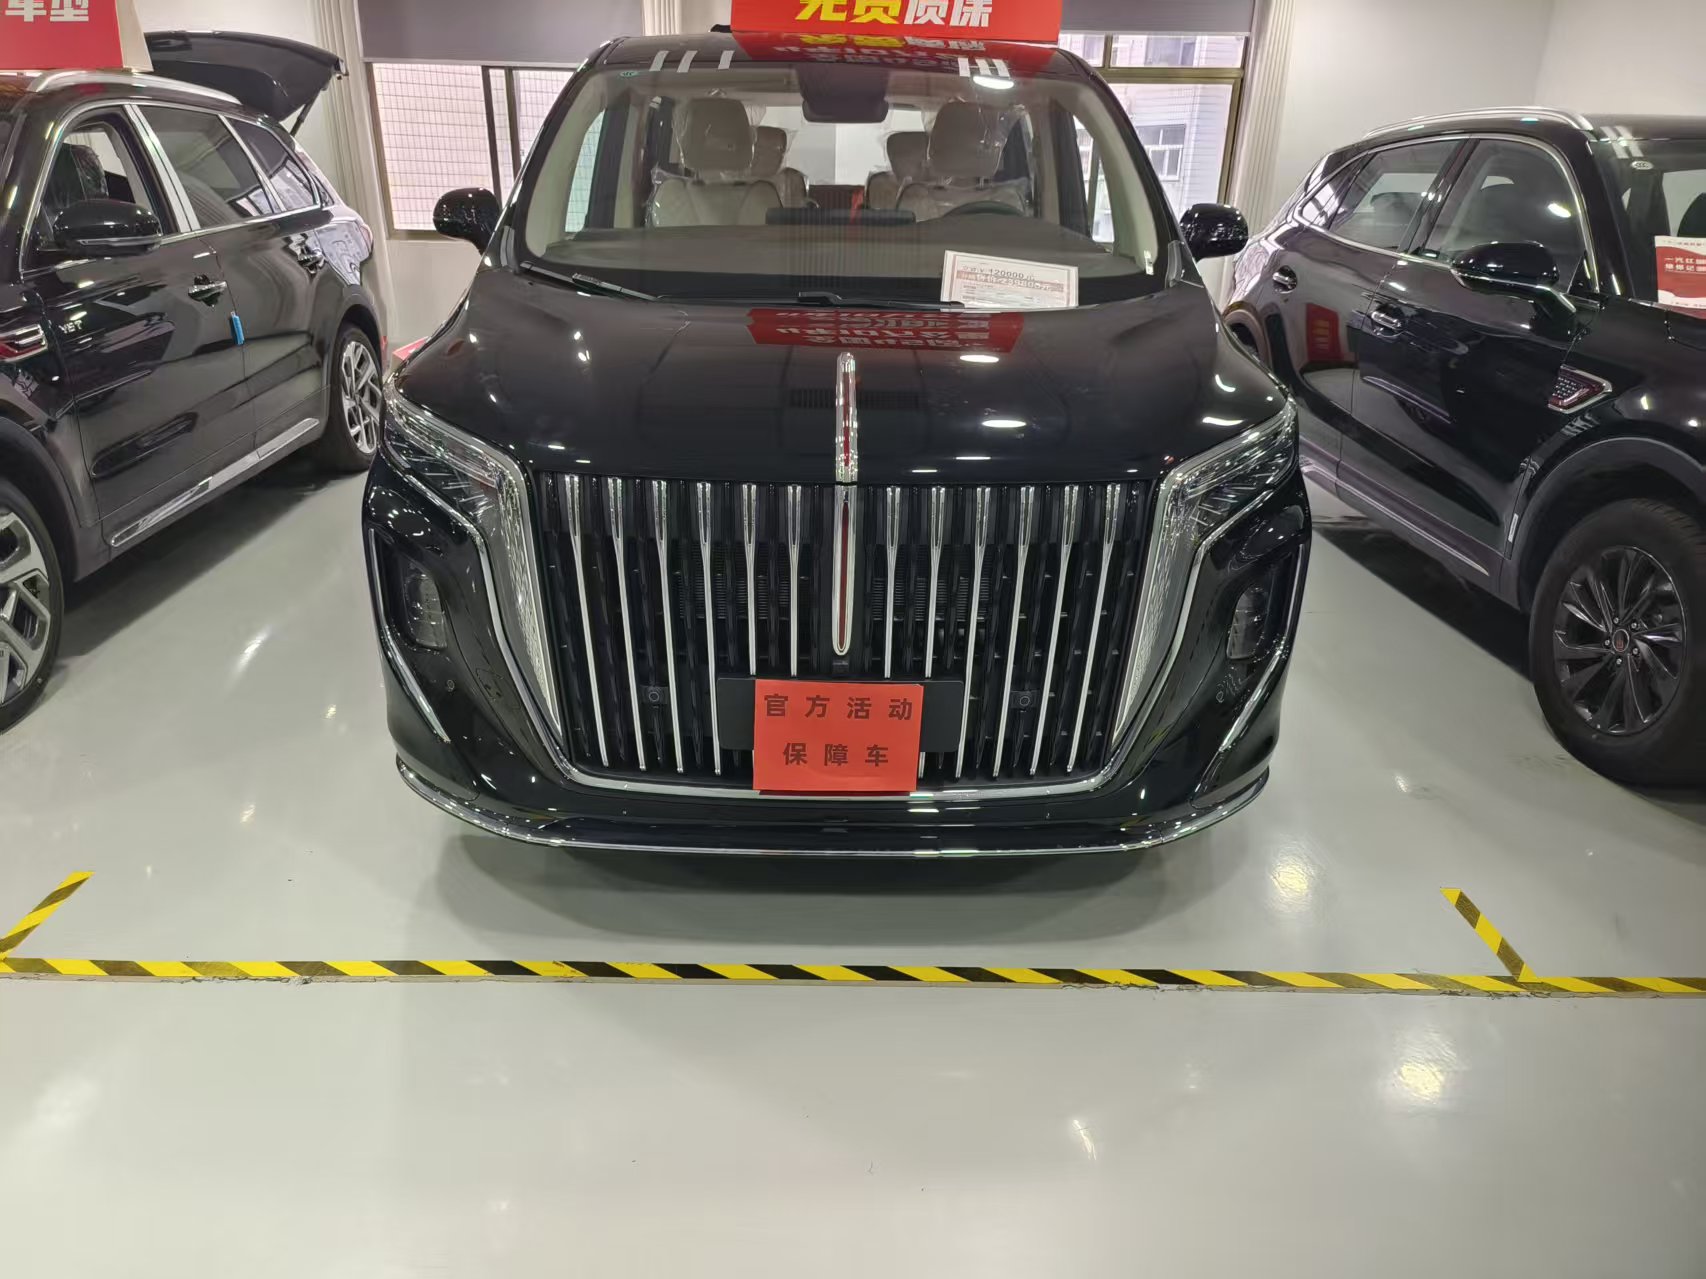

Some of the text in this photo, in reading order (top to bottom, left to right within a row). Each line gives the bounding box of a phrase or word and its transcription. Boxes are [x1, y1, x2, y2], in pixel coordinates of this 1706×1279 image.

[763, 693, 913, 721] 官方活动
[783, 742, 888, 767] 保障车
